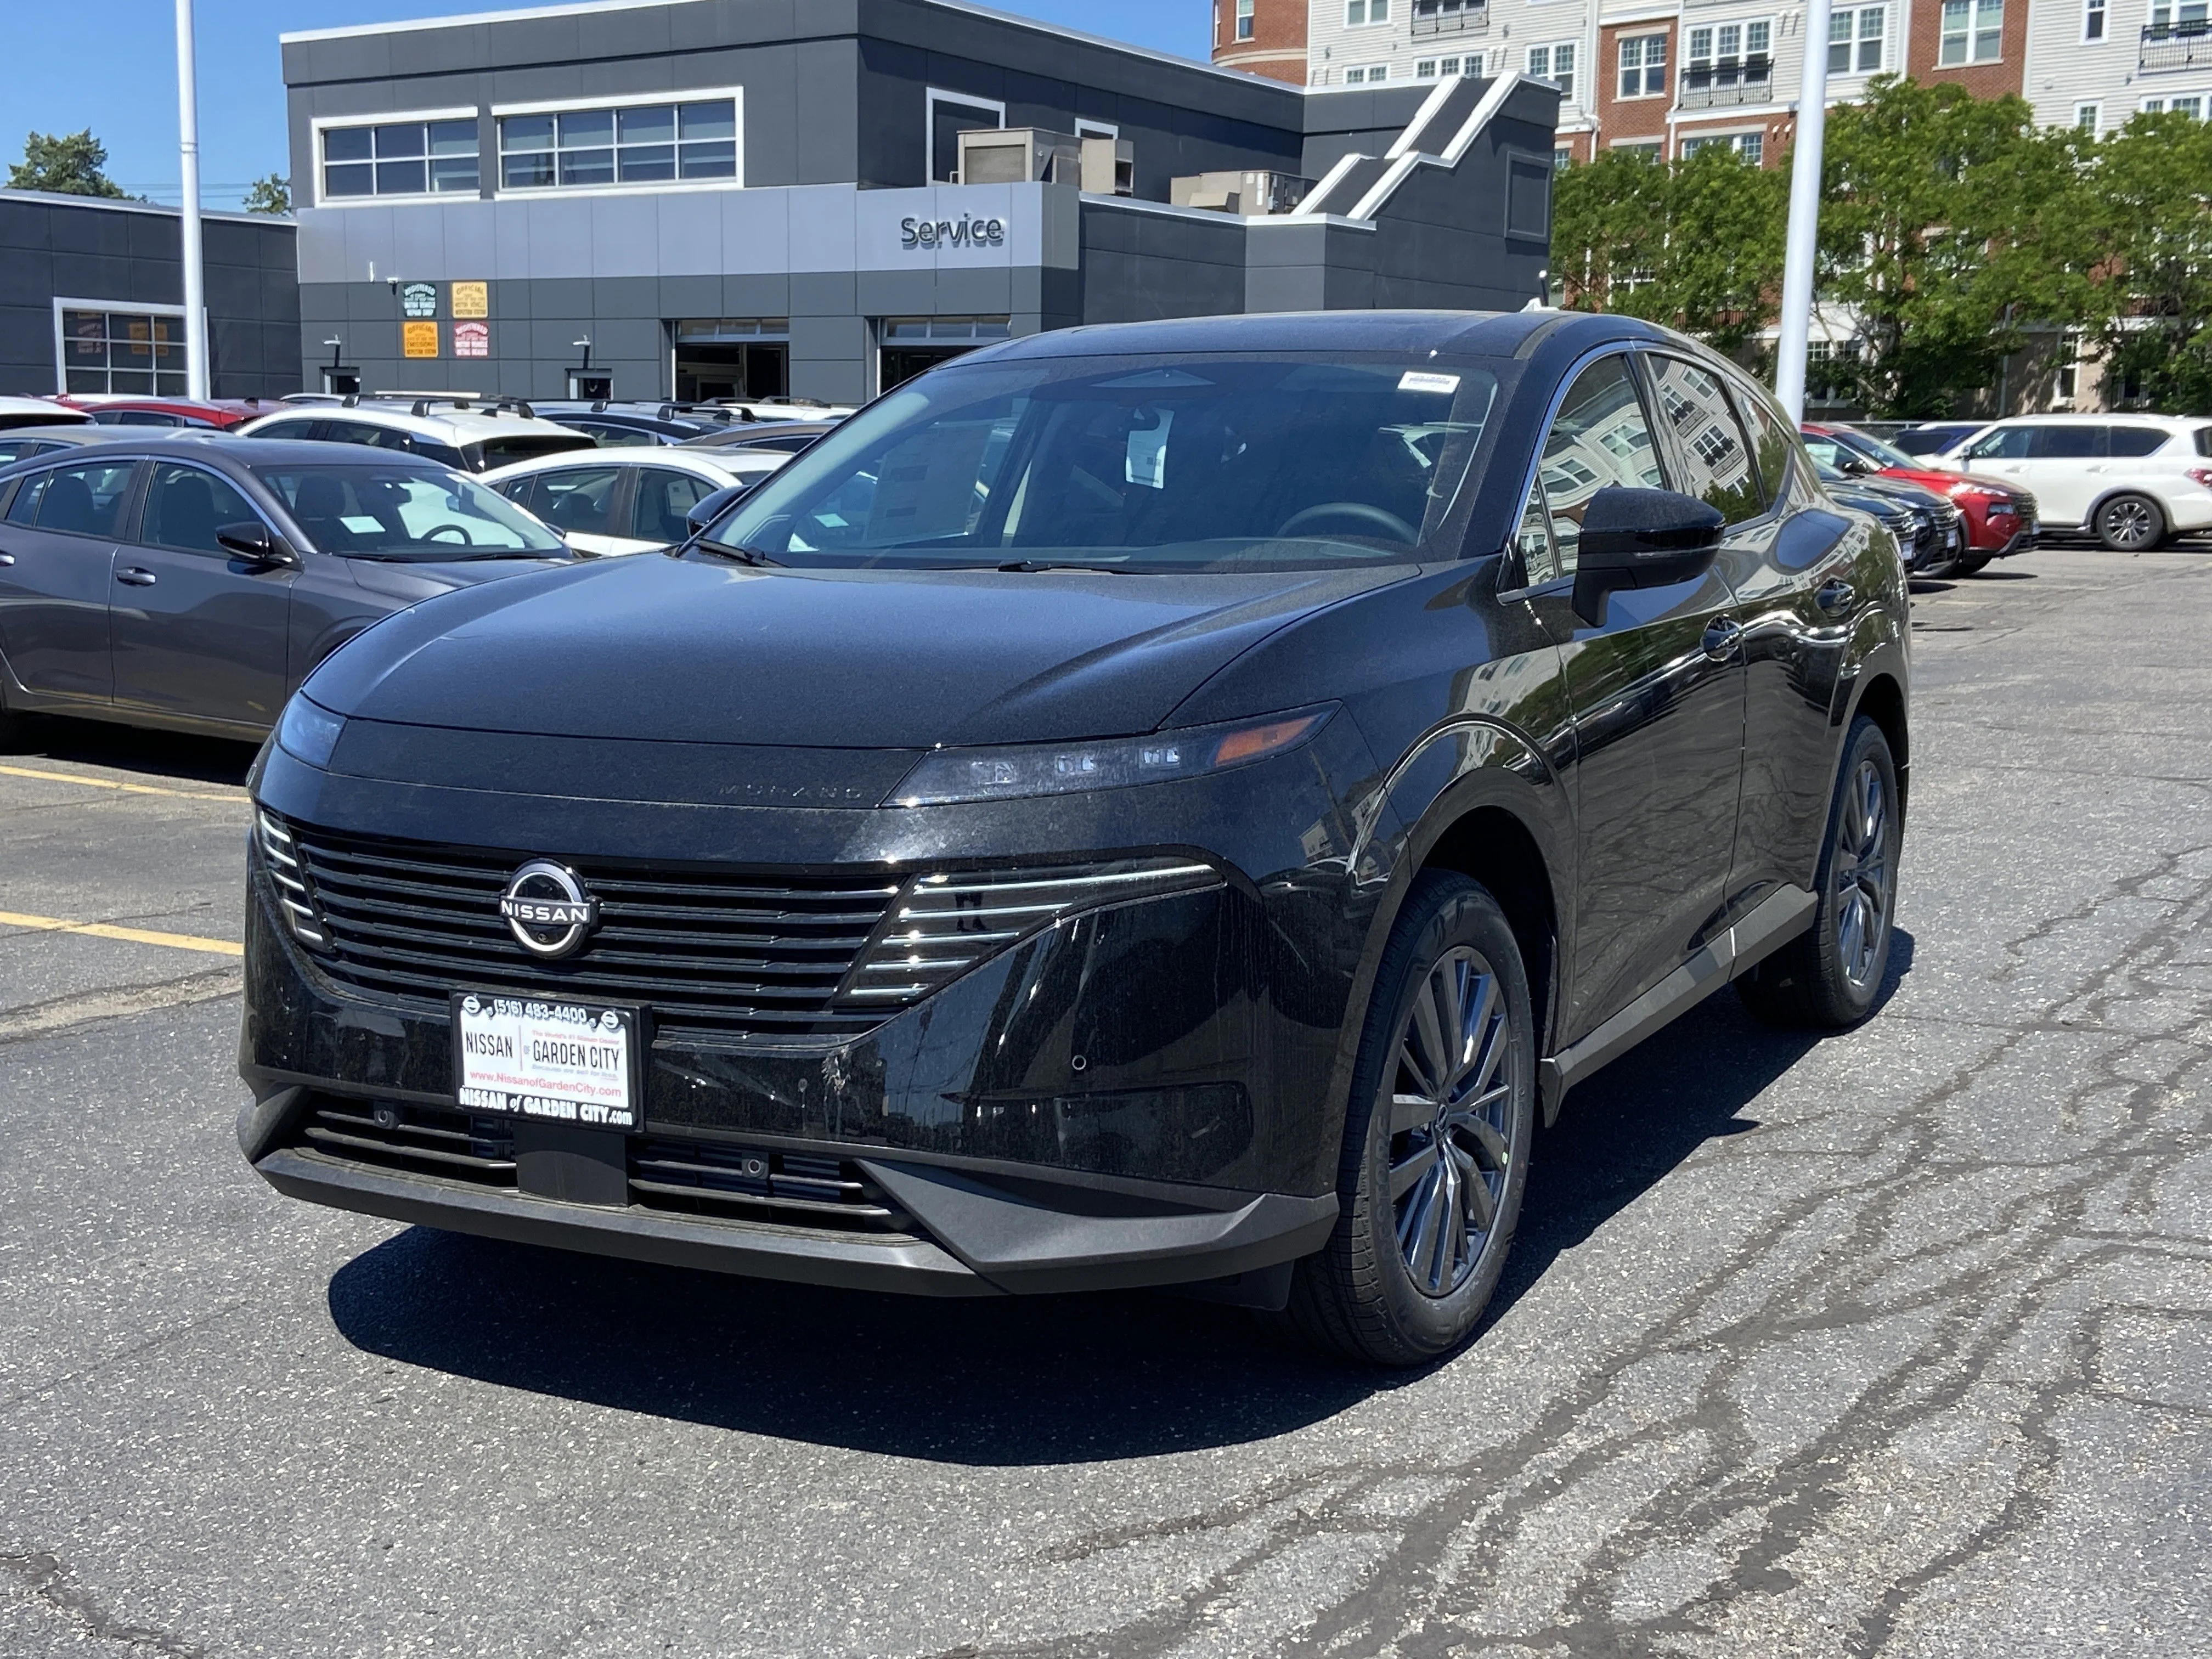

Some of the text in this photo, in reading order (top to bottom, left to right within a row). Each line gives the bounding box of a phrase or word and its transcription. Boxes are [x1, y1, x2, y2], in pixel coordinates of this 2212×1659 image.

[901, 212, 1003, 244] Service
[501, 900, 588, 922] NISSAN
[494, 998, 587, 1024] (516) 483-4400
[466, 1031, 513, 1058] NISSAN
[533, 1039, 586, 1067] GARDEN
[590, 1046, 619, 1071] CITY
[470, 1071, 622, 1097] www.NissanofGardenCity.com
[459, 1087, 633, 1125] NISSAN of GARDEN CITY.com
